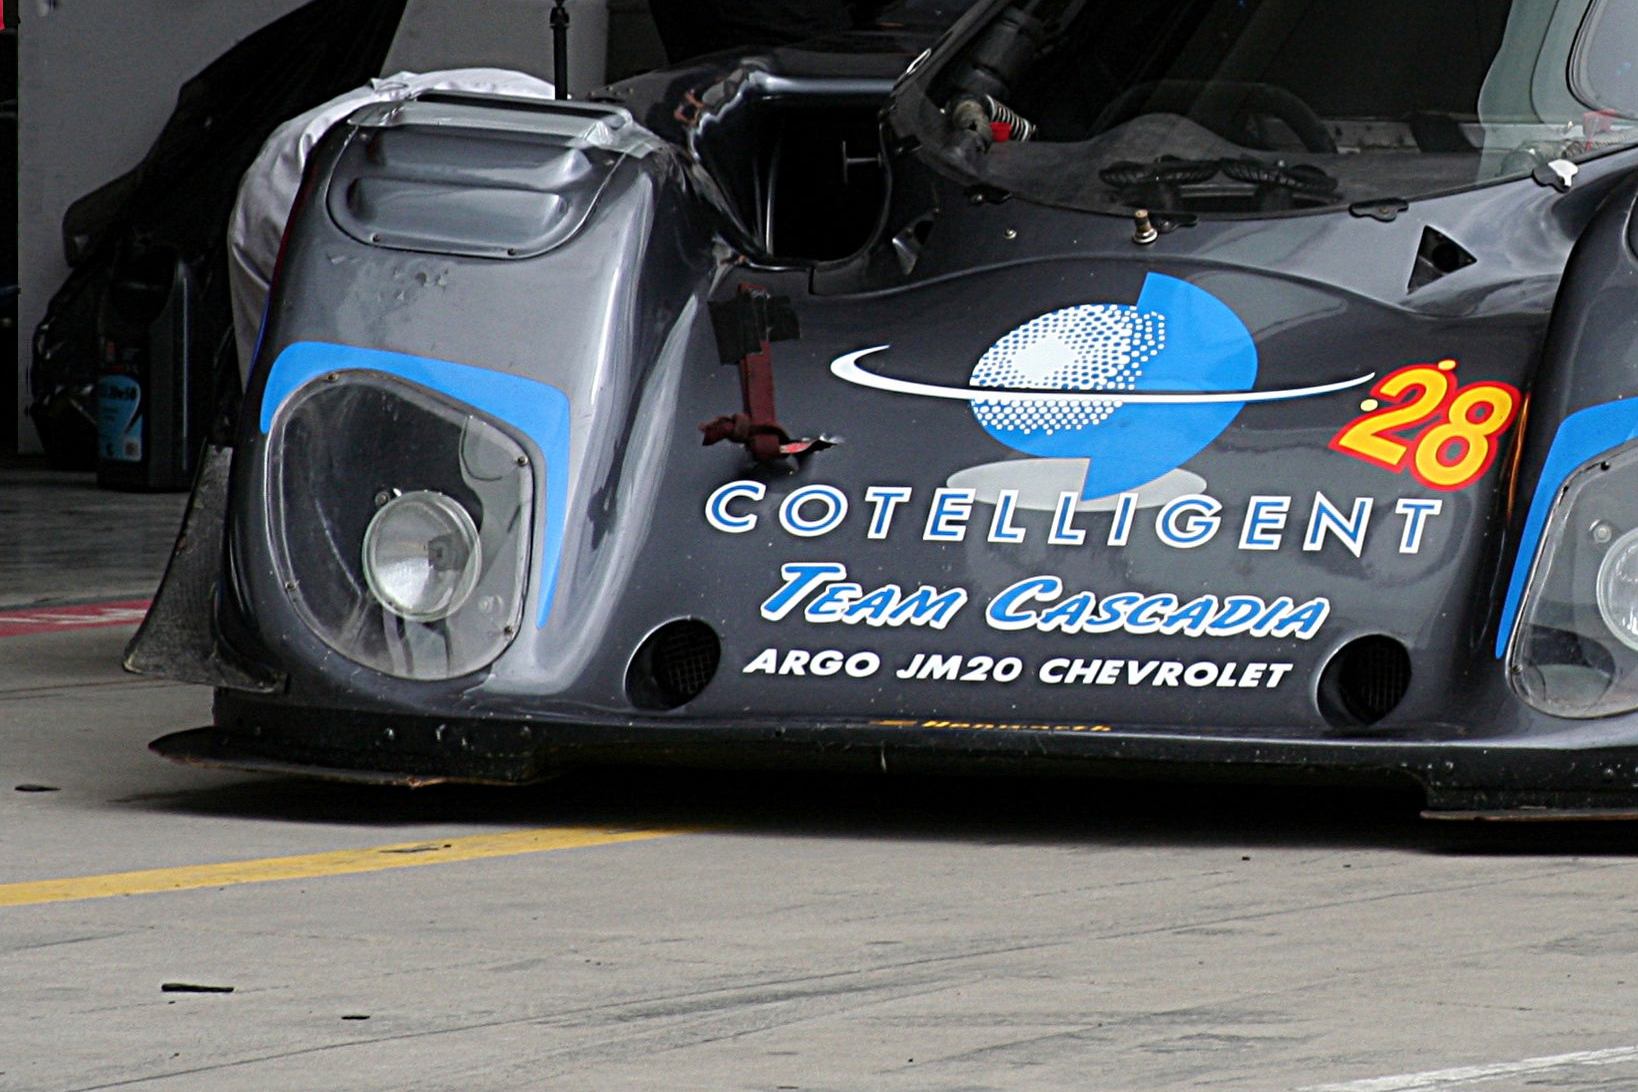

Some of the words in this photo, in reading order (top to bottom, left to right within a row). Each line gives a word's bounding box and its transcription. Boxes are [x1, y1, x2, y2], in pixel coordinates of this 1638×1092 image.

[1328, 360, 1521, 493] 28
[705, 480, 1443, 558] COTELLIGENT
[742, 648, 881, 678] ARGO
[896, 653, 1023, 683] JM20
[1039, 658, 1294, 688] CHEVROLET
